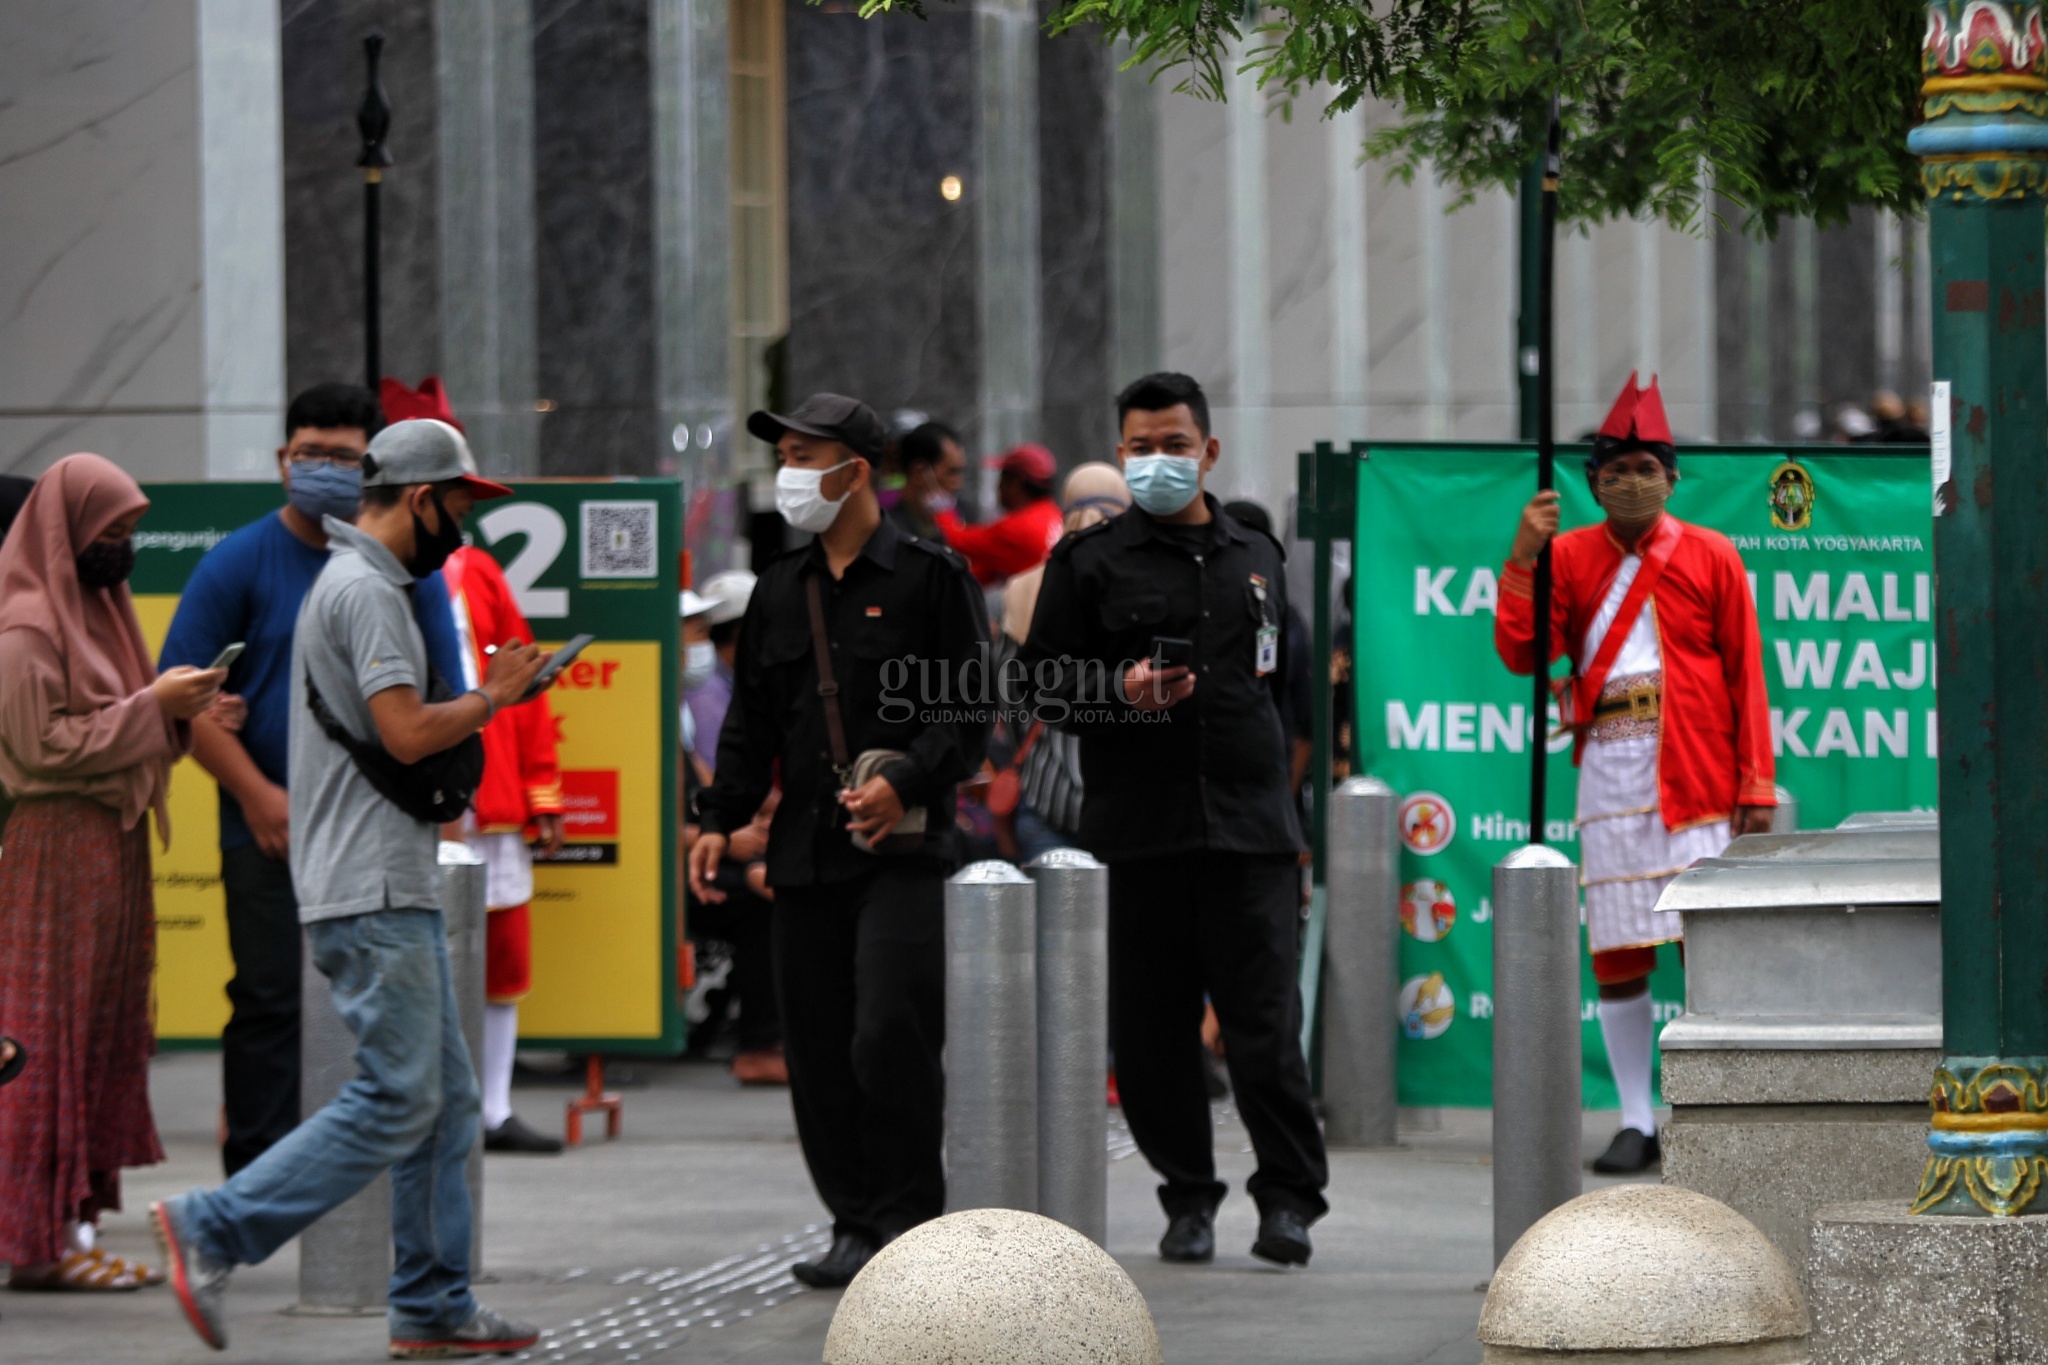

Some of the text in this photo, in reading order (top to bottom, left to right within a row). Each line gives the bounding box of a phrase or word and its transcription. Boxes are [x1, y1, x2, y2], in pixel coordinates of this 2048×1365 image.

[477, 502, 570, 618] 2
[1766, 535, 1811, 550] KOTA
[1813, 535, 1924, 552] YOGYAKARTA
